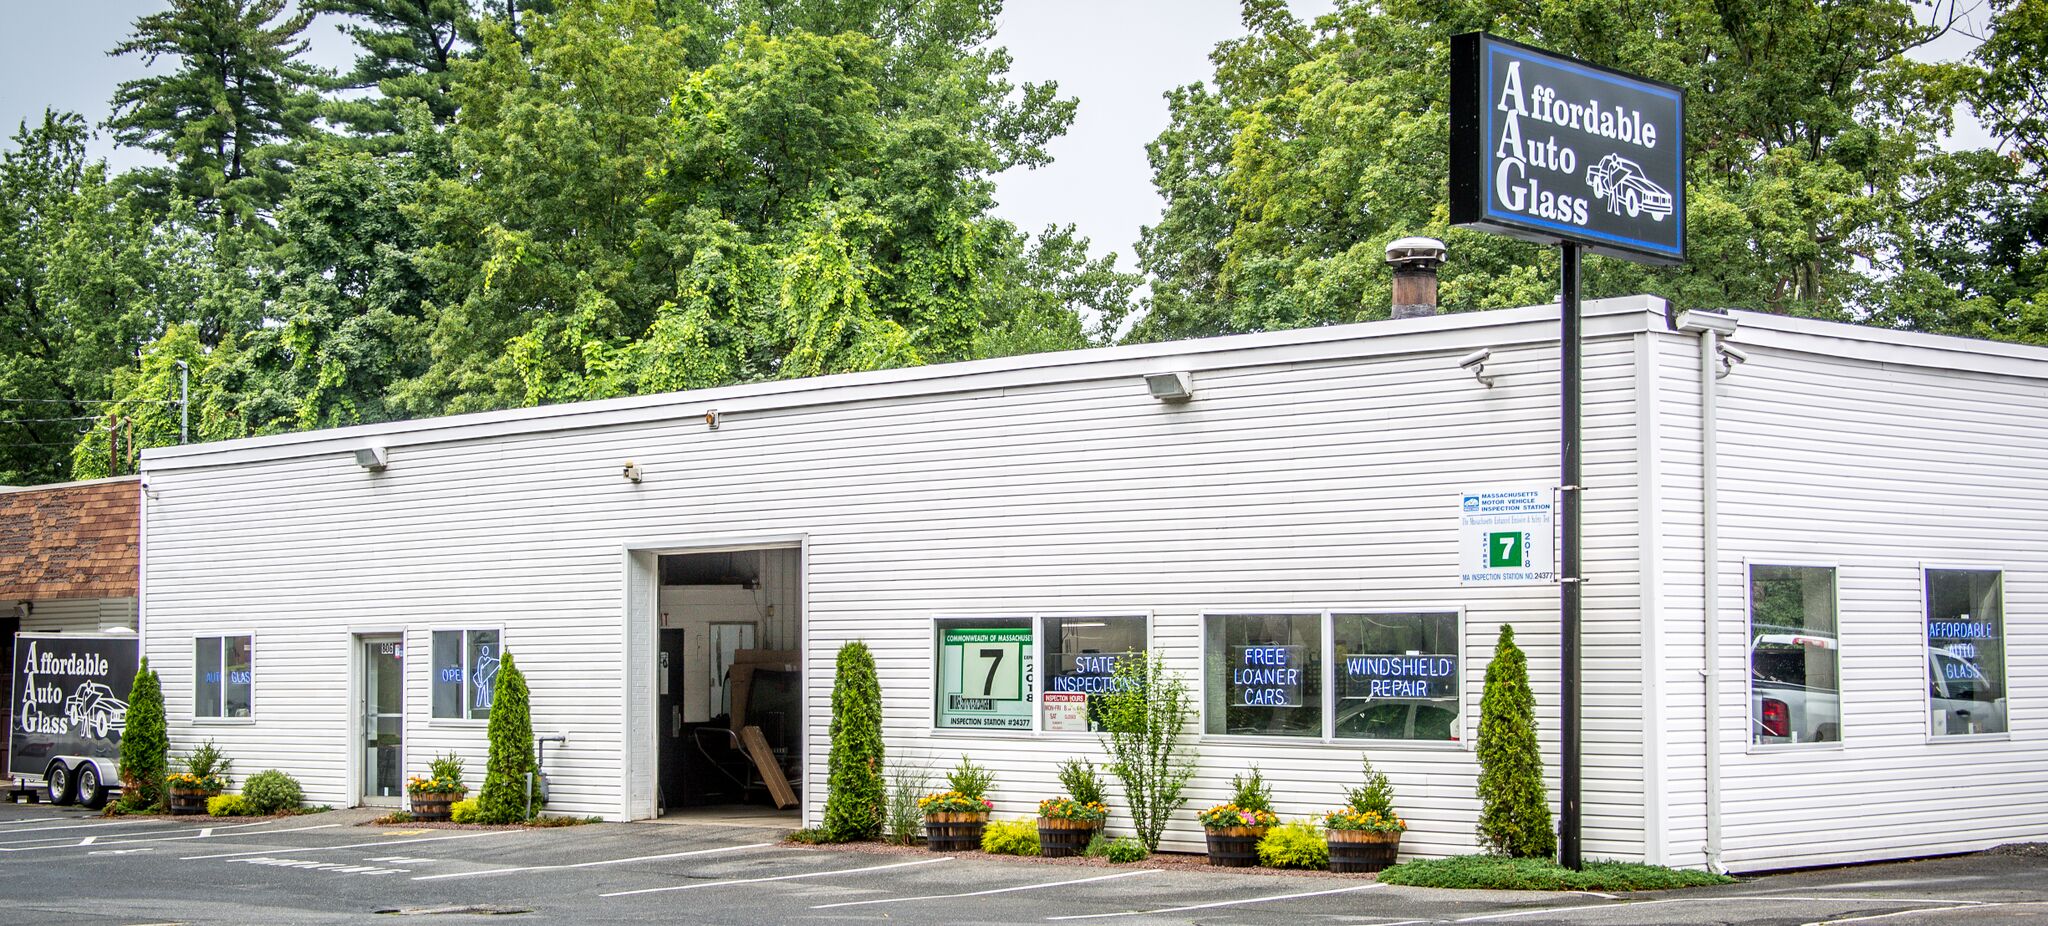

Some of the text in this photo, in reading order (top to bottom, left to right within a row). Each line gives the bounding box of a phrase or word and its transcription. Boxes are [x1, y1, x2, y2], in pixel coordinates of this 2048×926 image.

[1497, 61, 1656, 148] Affordable
[1496, 109, 1576, 174] Auto
[1496, 157, 1588, 225] Glass
[1482, 491, 1538, 499] MASSACHUSETTS
[1499, 537, 1515, 560] 7
[1929, 622, 1992, 638] AFFORDABLE
[24, 641, 108, 676] Affordable
[1245, 648, 1285, 665] FREE
[1949, 643, 1974, 658] AUTO
[979, 649, 1004, 696] 7
[1076, 656, 1115, 673] STATE
[1347, 658, 1449, 676] WINDSHIELD
[1946, 663, 1980, 678] GLASS
[206, 671, 250, 684] AUT GLAS
[442, 669, 463, 681] OPE
[1234, 668, 1296, 685] LOANER
[22, 671, 62, 704] Auto
[1371, 680, 1427, 697] REPAIR
[22, 700, 68, 734] Glass
